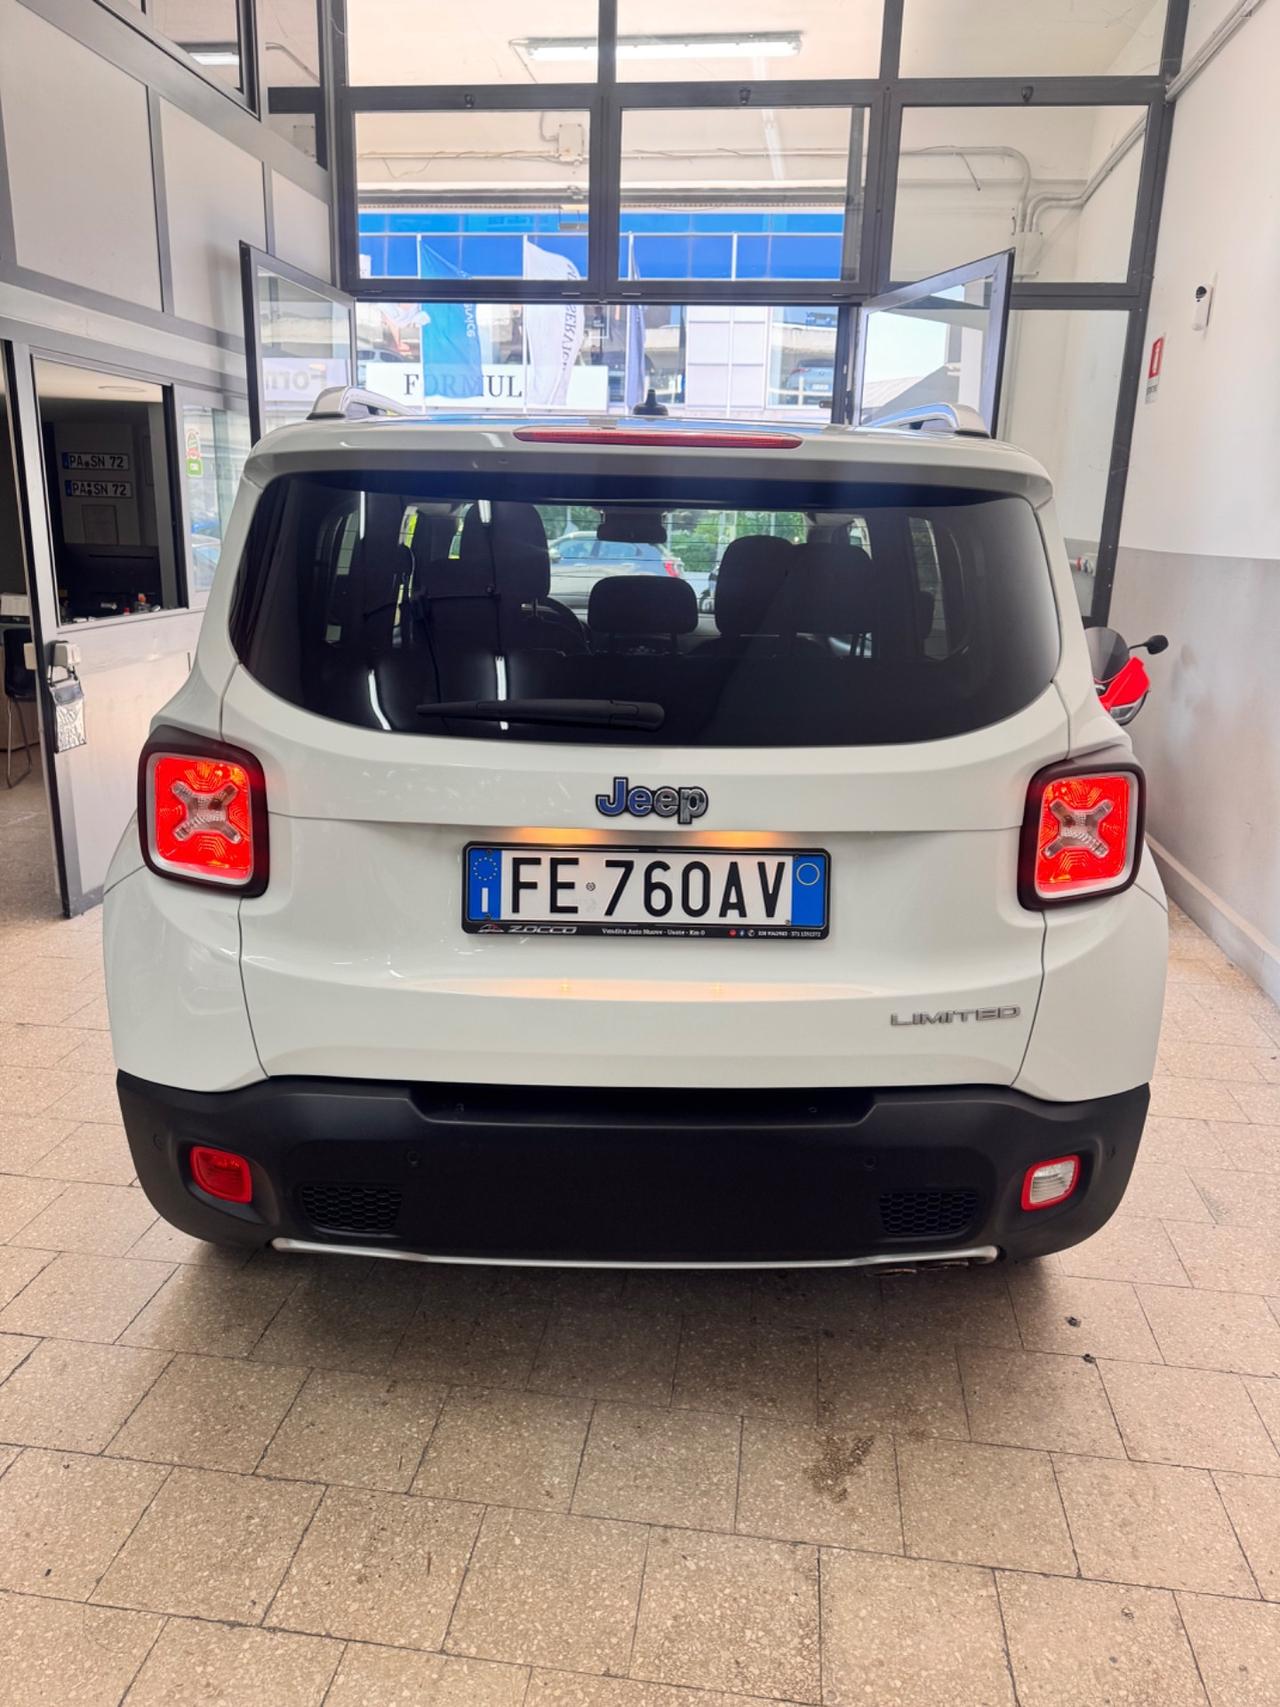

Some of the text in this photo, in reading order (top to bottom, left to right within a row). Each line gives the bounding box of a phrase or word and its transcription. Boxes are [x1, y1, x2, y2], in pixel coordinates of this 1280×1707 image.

[404, 374, 523, 398] FORMUL
[109, 456, 124, 469] 72
[112, 483, 127, 496] 72
[595, 776, 709, 825] Jeep
[512, 857, 580, 914] FE
[604, 860, 786, 918] 760AV
[508, 925, 578, 934] ZOCCO
[890, 1005, 1021, 1026] LIMITED
